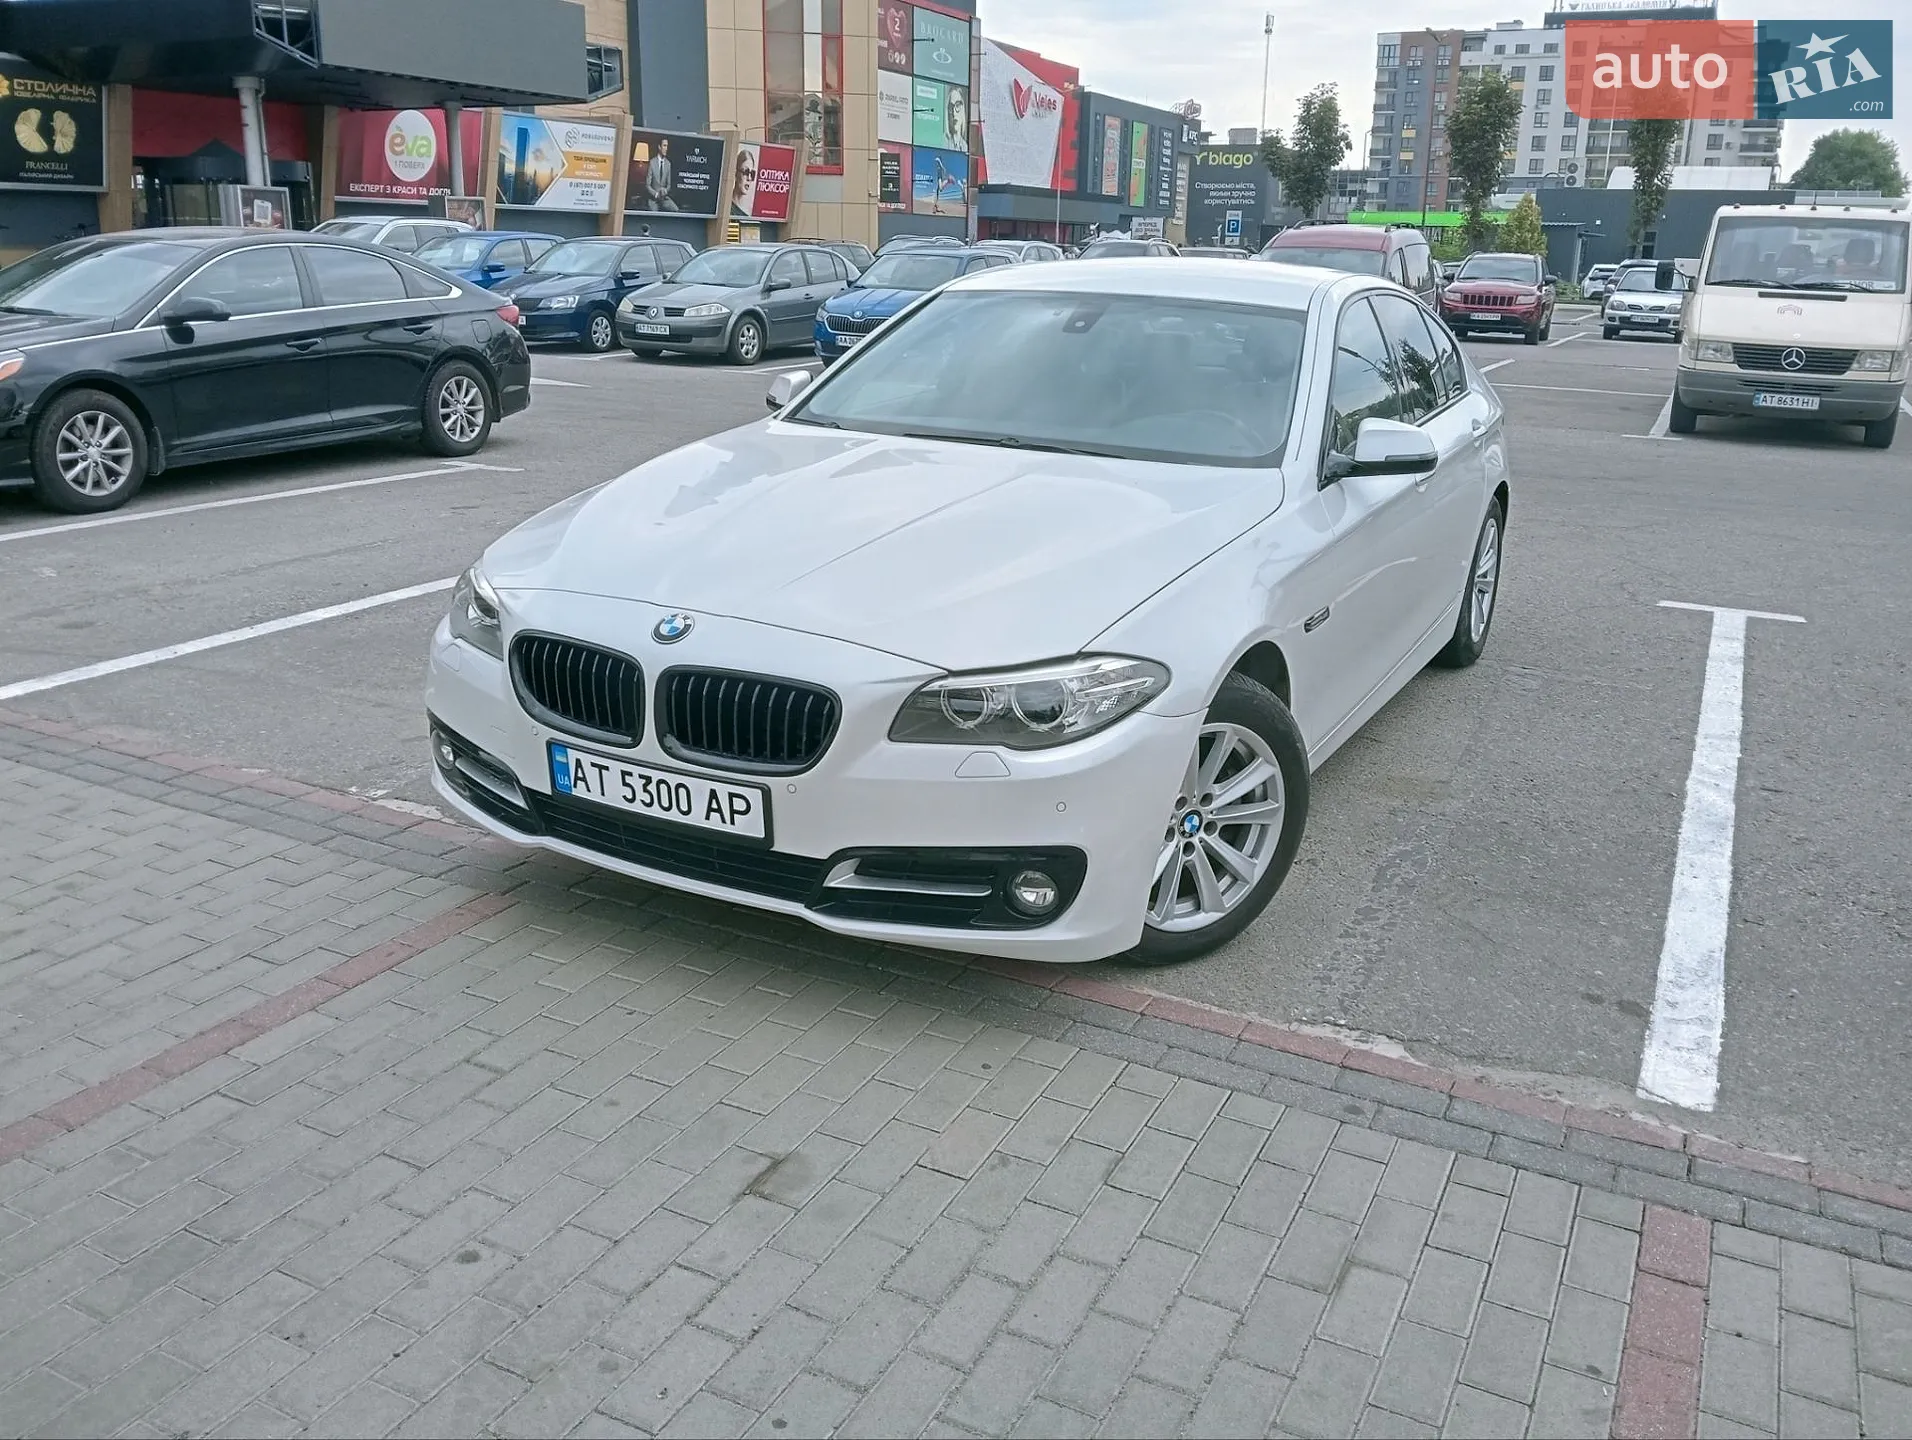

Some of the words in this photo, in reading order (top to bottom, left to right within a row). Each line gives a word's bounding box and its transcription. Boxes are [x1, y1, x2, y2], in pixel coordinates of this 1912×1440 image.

[13, 78, 97, 97] СТОЛИЧНА
[1034, 91, 1057, 111] Veles
[25, 160, 68, 170] FRANCELLI
[399, 160, 425, 170] ПОВЕРХ
[1208, 151, 1254, 169] blago
[759, 169, 790, 180] ОПТИКА
[349, 183, 384, 192] ЕКСПЕРТ
[385, 186, 391, 194] З
[391, 186, 417, 195] КРАСИ
[418, 186, 428, 195] ТА
[757, 182, 790, 193] ЛЮКСОР
[1195, 181, 1235, 192] Створюємо
[1229, 220, 1238, 232] P
[1761, 395, 1775, 405] AT
[1777, 396, 1800, 406] 8631
[557, 775, 571, 787] UA
[573, 757, 610, 797] AT
[620, 769, 693, 816] 5300
[704, 788, 752, 826] AP
